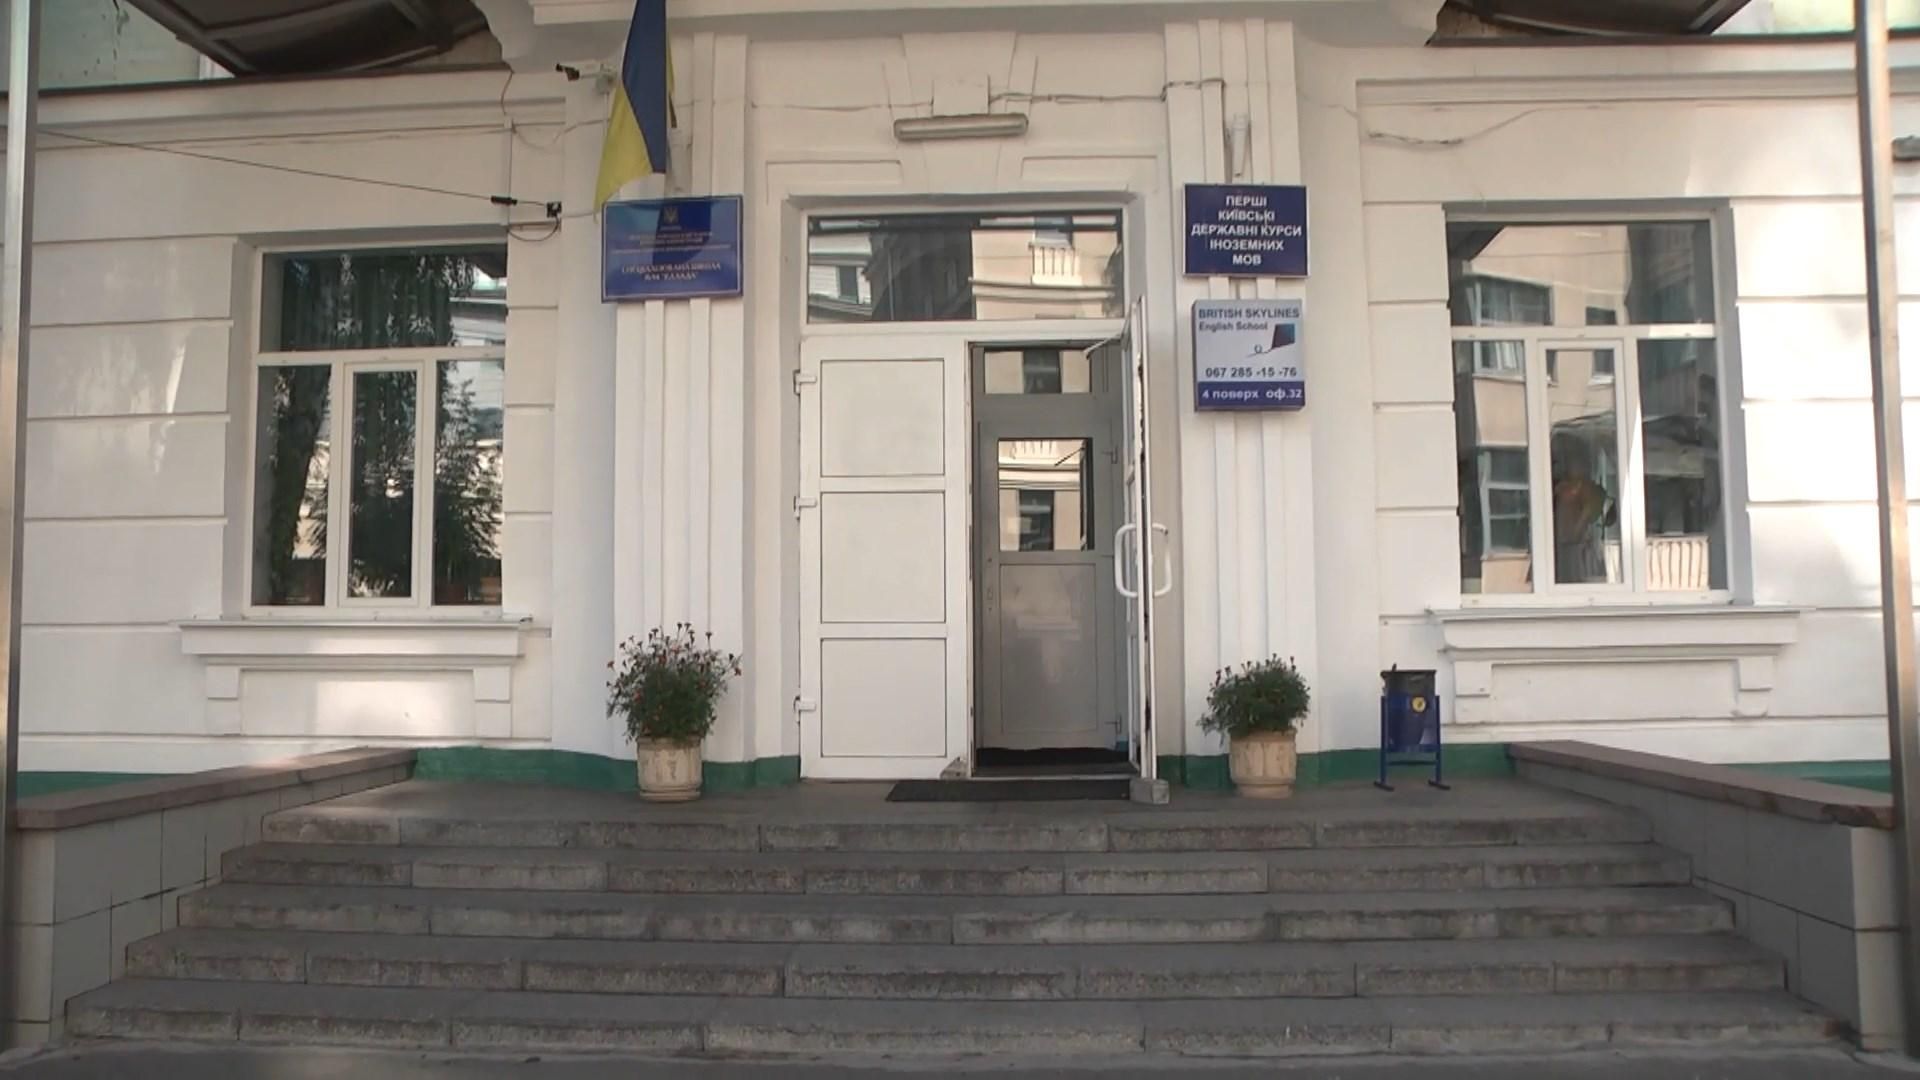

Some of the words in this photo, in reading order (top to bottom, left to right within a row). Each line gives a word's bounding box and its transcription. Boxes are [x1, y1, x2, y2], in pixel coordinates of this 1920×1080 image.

[1225, 195, 1267, 206] ПЕРШІ
[1218, 208, 1275, 221] КИЇВСЬКІ
[1191, 224, 1258, 236] ДЕРЖАВНІ
[1261, 225, 1302, 236] КУРСИ
[1210, 239, 1284, 250] ІНОЗЕМНИХ
[1232, 254, 1262, 265] МОВ
[1198, 308, 1242, 319] BRITISH
[1245, 308, 1300, 318] SKYLINES
[1199, 321, 1234, 332] English
[1236, 321, 1268, 330] School
[1205, 367, 1227, 378] 067
[1231, 367, 1253, 377] 285
[1202, 390, 1209, 398] 4
[1212, 390, 1259, 401] поверх
[1265, 388, 1302, 400] оф.32
